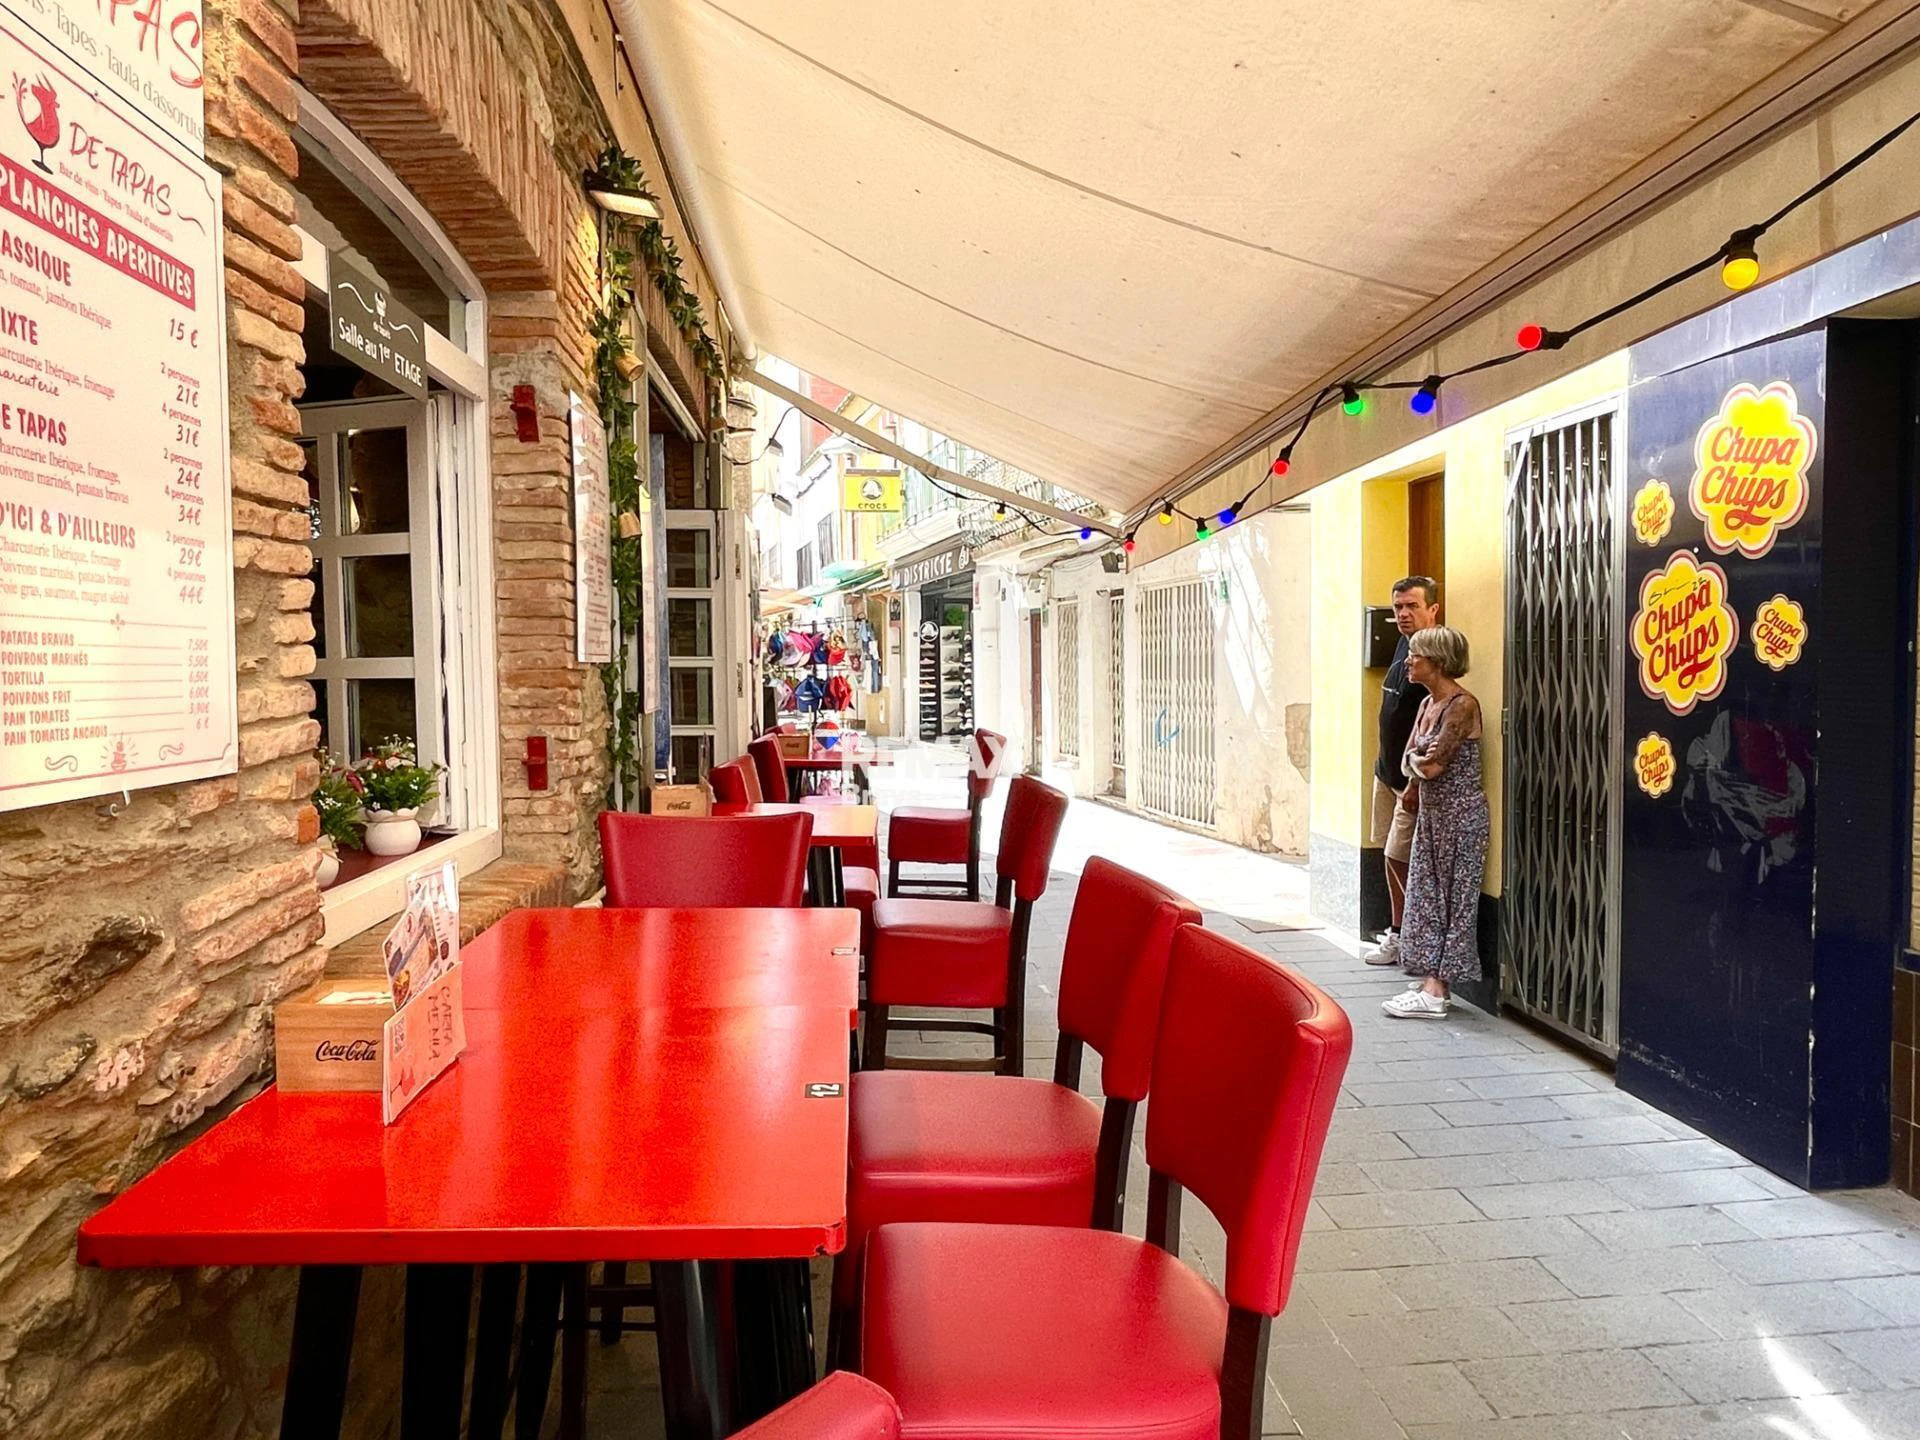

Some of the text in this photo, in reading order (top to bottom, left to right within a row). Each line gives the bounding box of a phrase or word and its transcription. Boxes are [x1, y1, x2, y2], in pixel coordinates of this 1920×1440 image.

[52, 2, 98, 58] Tapes
[105, 44, 140, 92] Taula
[69, 121, 172, 216] DE TAPAS
[0, 163, 193, 301] PLANCHES APERITIVES
[1, 229, 72, 287] ASSIQUE
[1, 306, 38, 346] IXTE
[169, 317, 198, 349] 15 €
[338, 316, 364, 352] Salle
[364, 338, 377, 361] au
[394, 351, 423, 388] ETAGE
[0, 368, 60, 398] arcuterie
[176, 384, 200, 409] 21€
[2, 402, 67, 447] E TAPAS
[176, 424, 200, 448] 31€
[1710, 426, 1801, 476] Chupa
[176, 466, 201, 491] 24€
[857, 502, 888, 510] crocs
[1637, 489, 1664, 522] Chupa
[1701, 465, 1790, 531] Chups
[40, 509, 52, 535] &
[58, 511, 136, 549] D'AILLEURS
[178, 504, 202, 527] 34€
[1641, 503, 1668, 536] Chups
[178, 547, 203, 568] 29€
[903, 551, 953, 587] DISTRICTE
[179, 585, 204, 606] 44€
[1643, 579, 1713, 646] Chupa
[1764, 608, 1801, 639] Chupa
[0, 629, 39, 646] PATATAS
[41, 631, 75, 648] BRAVAS
[1648, 615, 1720, 690] Chups
[1756, 623, 1795, 659] Chups
[1, 650, 49, 667] POIVRONS
[1, 670, 45, 686] TORTILLA
[2, 690, 50, 706] POIVRONS
[52, 690, 72, 704] FRIT
[3, 711, 26, 727] PAIN
[29, 708, 71, 725] TOMATES
[3, 730, 27, 747] PAIN
[30, 727, 71, 744] TOMATES
[1639, 744, 1666, 770] Chupa
[1641, 759, 1669, 788] Chups
